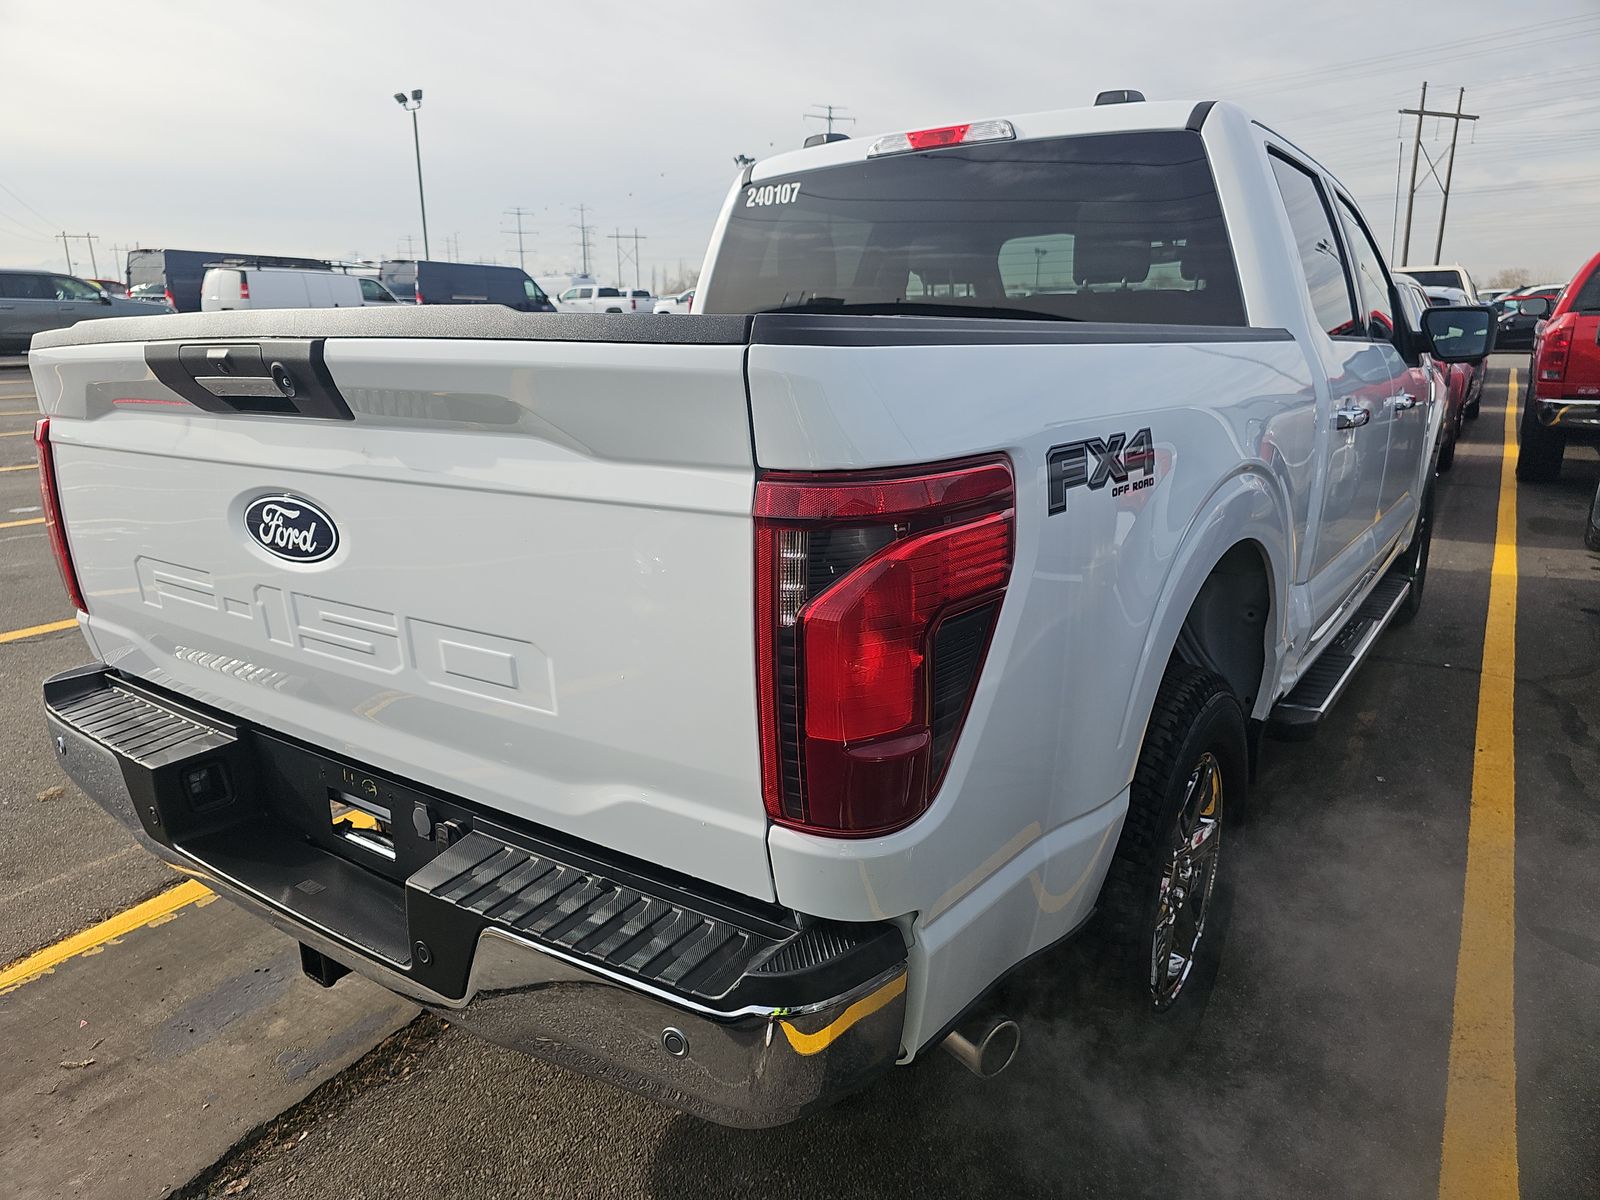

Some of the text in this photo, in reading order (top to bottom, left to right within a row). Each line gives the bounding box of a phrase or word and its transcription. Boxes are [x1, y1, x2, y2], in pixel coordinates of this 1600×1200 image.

[746, 182, 801, 207] 240107
[1045, 426, 1155, 517] FX4
[1111, 477, 1155, 497] OFF ROAD
[259, 503, 317, 553] Ford
[134, 555, 559, 716] F-150
